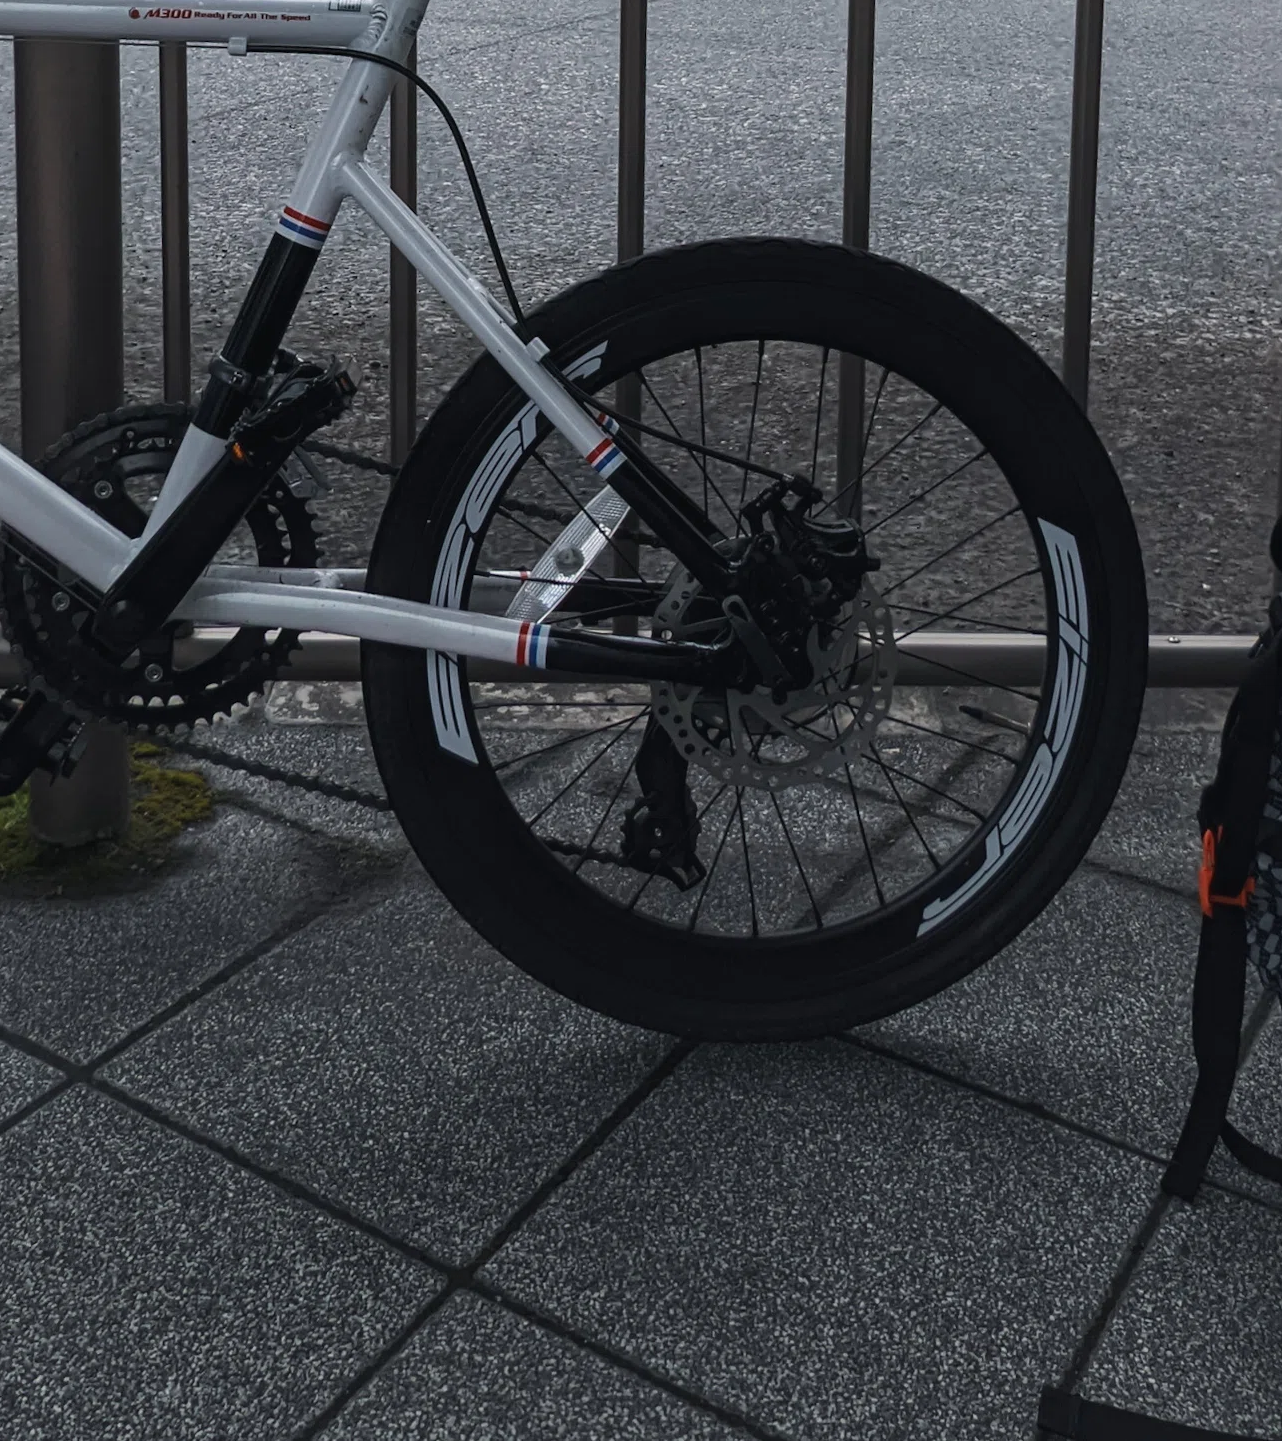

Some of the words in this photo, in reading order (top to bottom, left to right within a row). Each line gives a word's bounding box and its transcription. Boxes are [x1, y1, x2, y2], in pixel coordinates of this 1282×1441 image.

[194, 11, 224, 20] Ready
[244, 12, 257, 20] All
[281, 13, 311, 22] Speed
